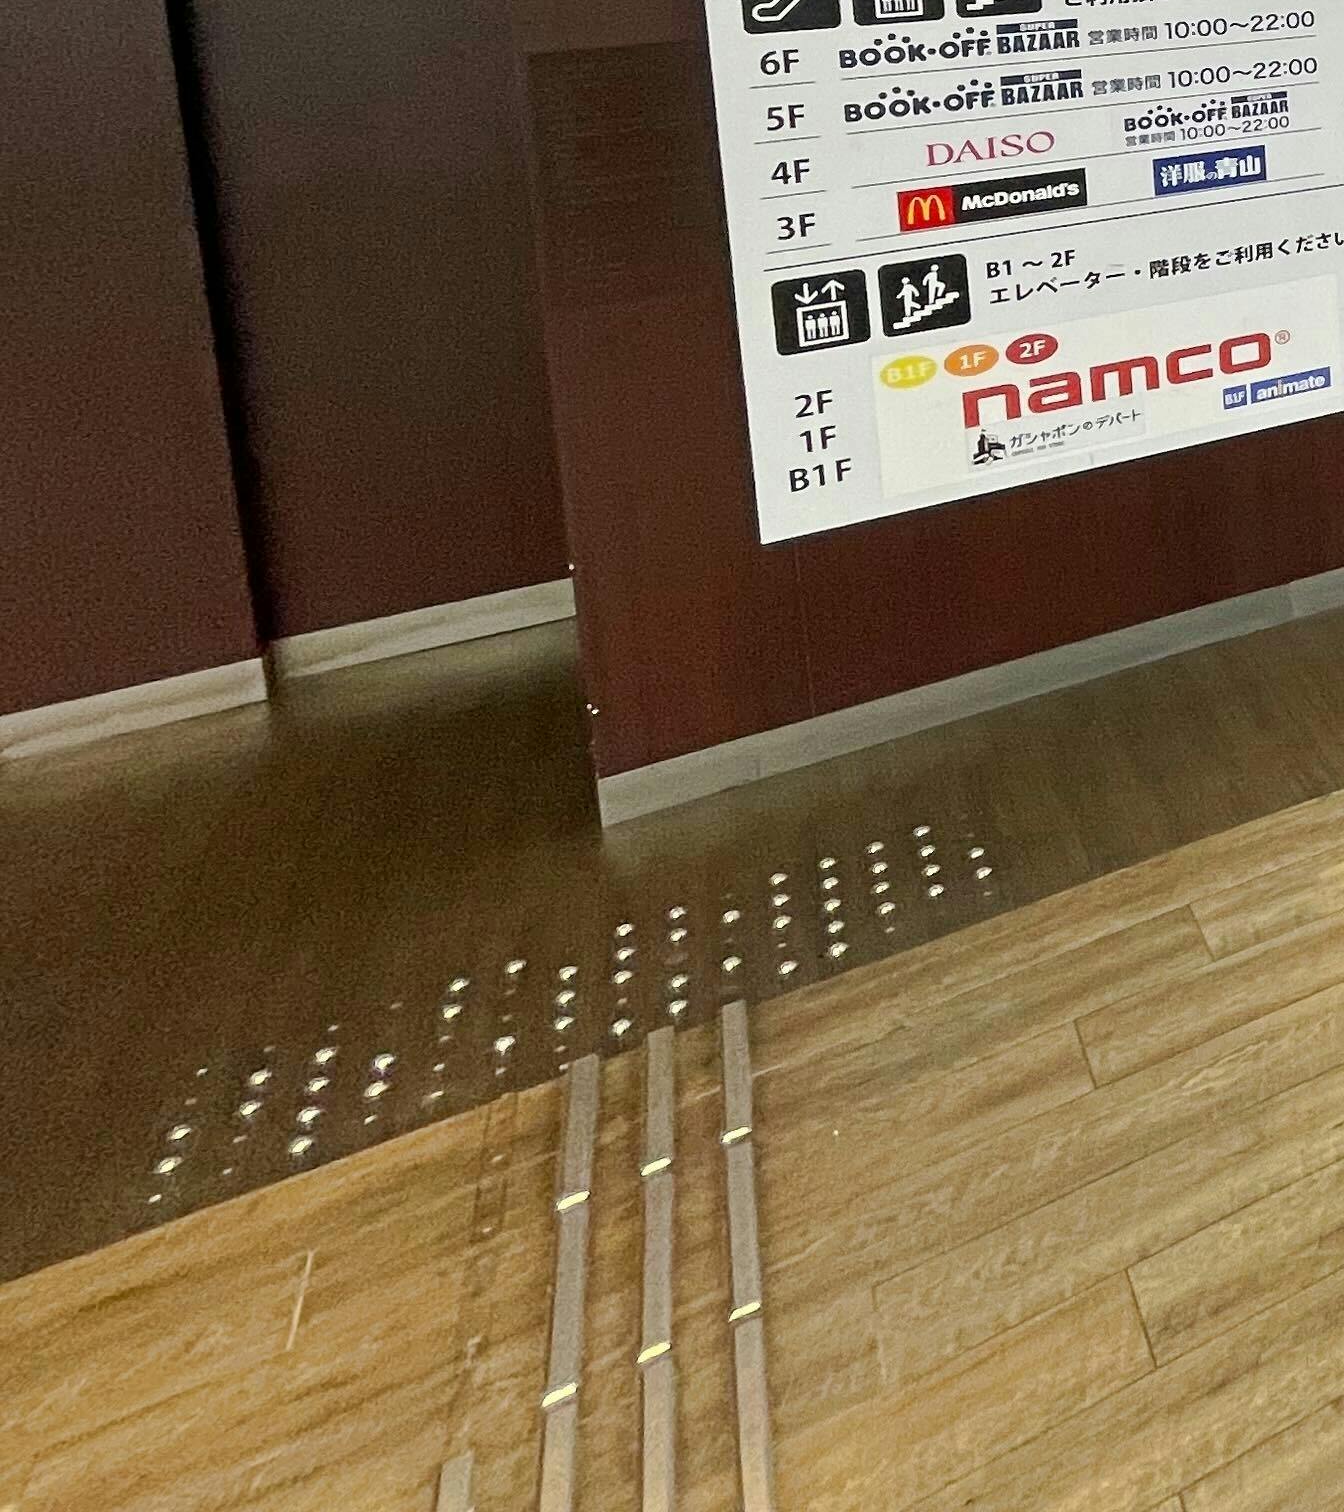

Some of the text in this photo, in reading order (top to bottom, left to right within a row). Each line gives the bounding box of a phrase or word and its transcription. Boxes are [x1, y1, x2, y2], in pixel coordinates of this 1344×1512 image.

[760, 49, 800, 75] 6F
[998, 30, 1080, 55] BAZAAR
[767, 104, 805, 131] 5F
[1001, 81, 1084, 106] BAZAAR
[1231, 99, 1289, 119] BAZAAR
[926, 131, 1055, 167] DAISO
[771, 158, 811, 185] 4F
[1160, 155, 1262, 187] 洋服の青山
[961, 182, 1080, 211] McDonald's
[777, 212, 816, 240] 3F
[986, 260, 1012, 279] B1
[1051, 249, 1076, 268] 2F
[960, 351, 989, 370] 1F
[1019, 338, 1046, 358] 2F
[962, 332, 1272, 429] namco
[1256, 374, 1326, 403] animate
[794, 389, 833, 418] 2F
[799, 424, 837, 454] 1F
[1010, 408, 1142, 449] ガシャポンのデパート
[789, 457, 852, 493] B1F
